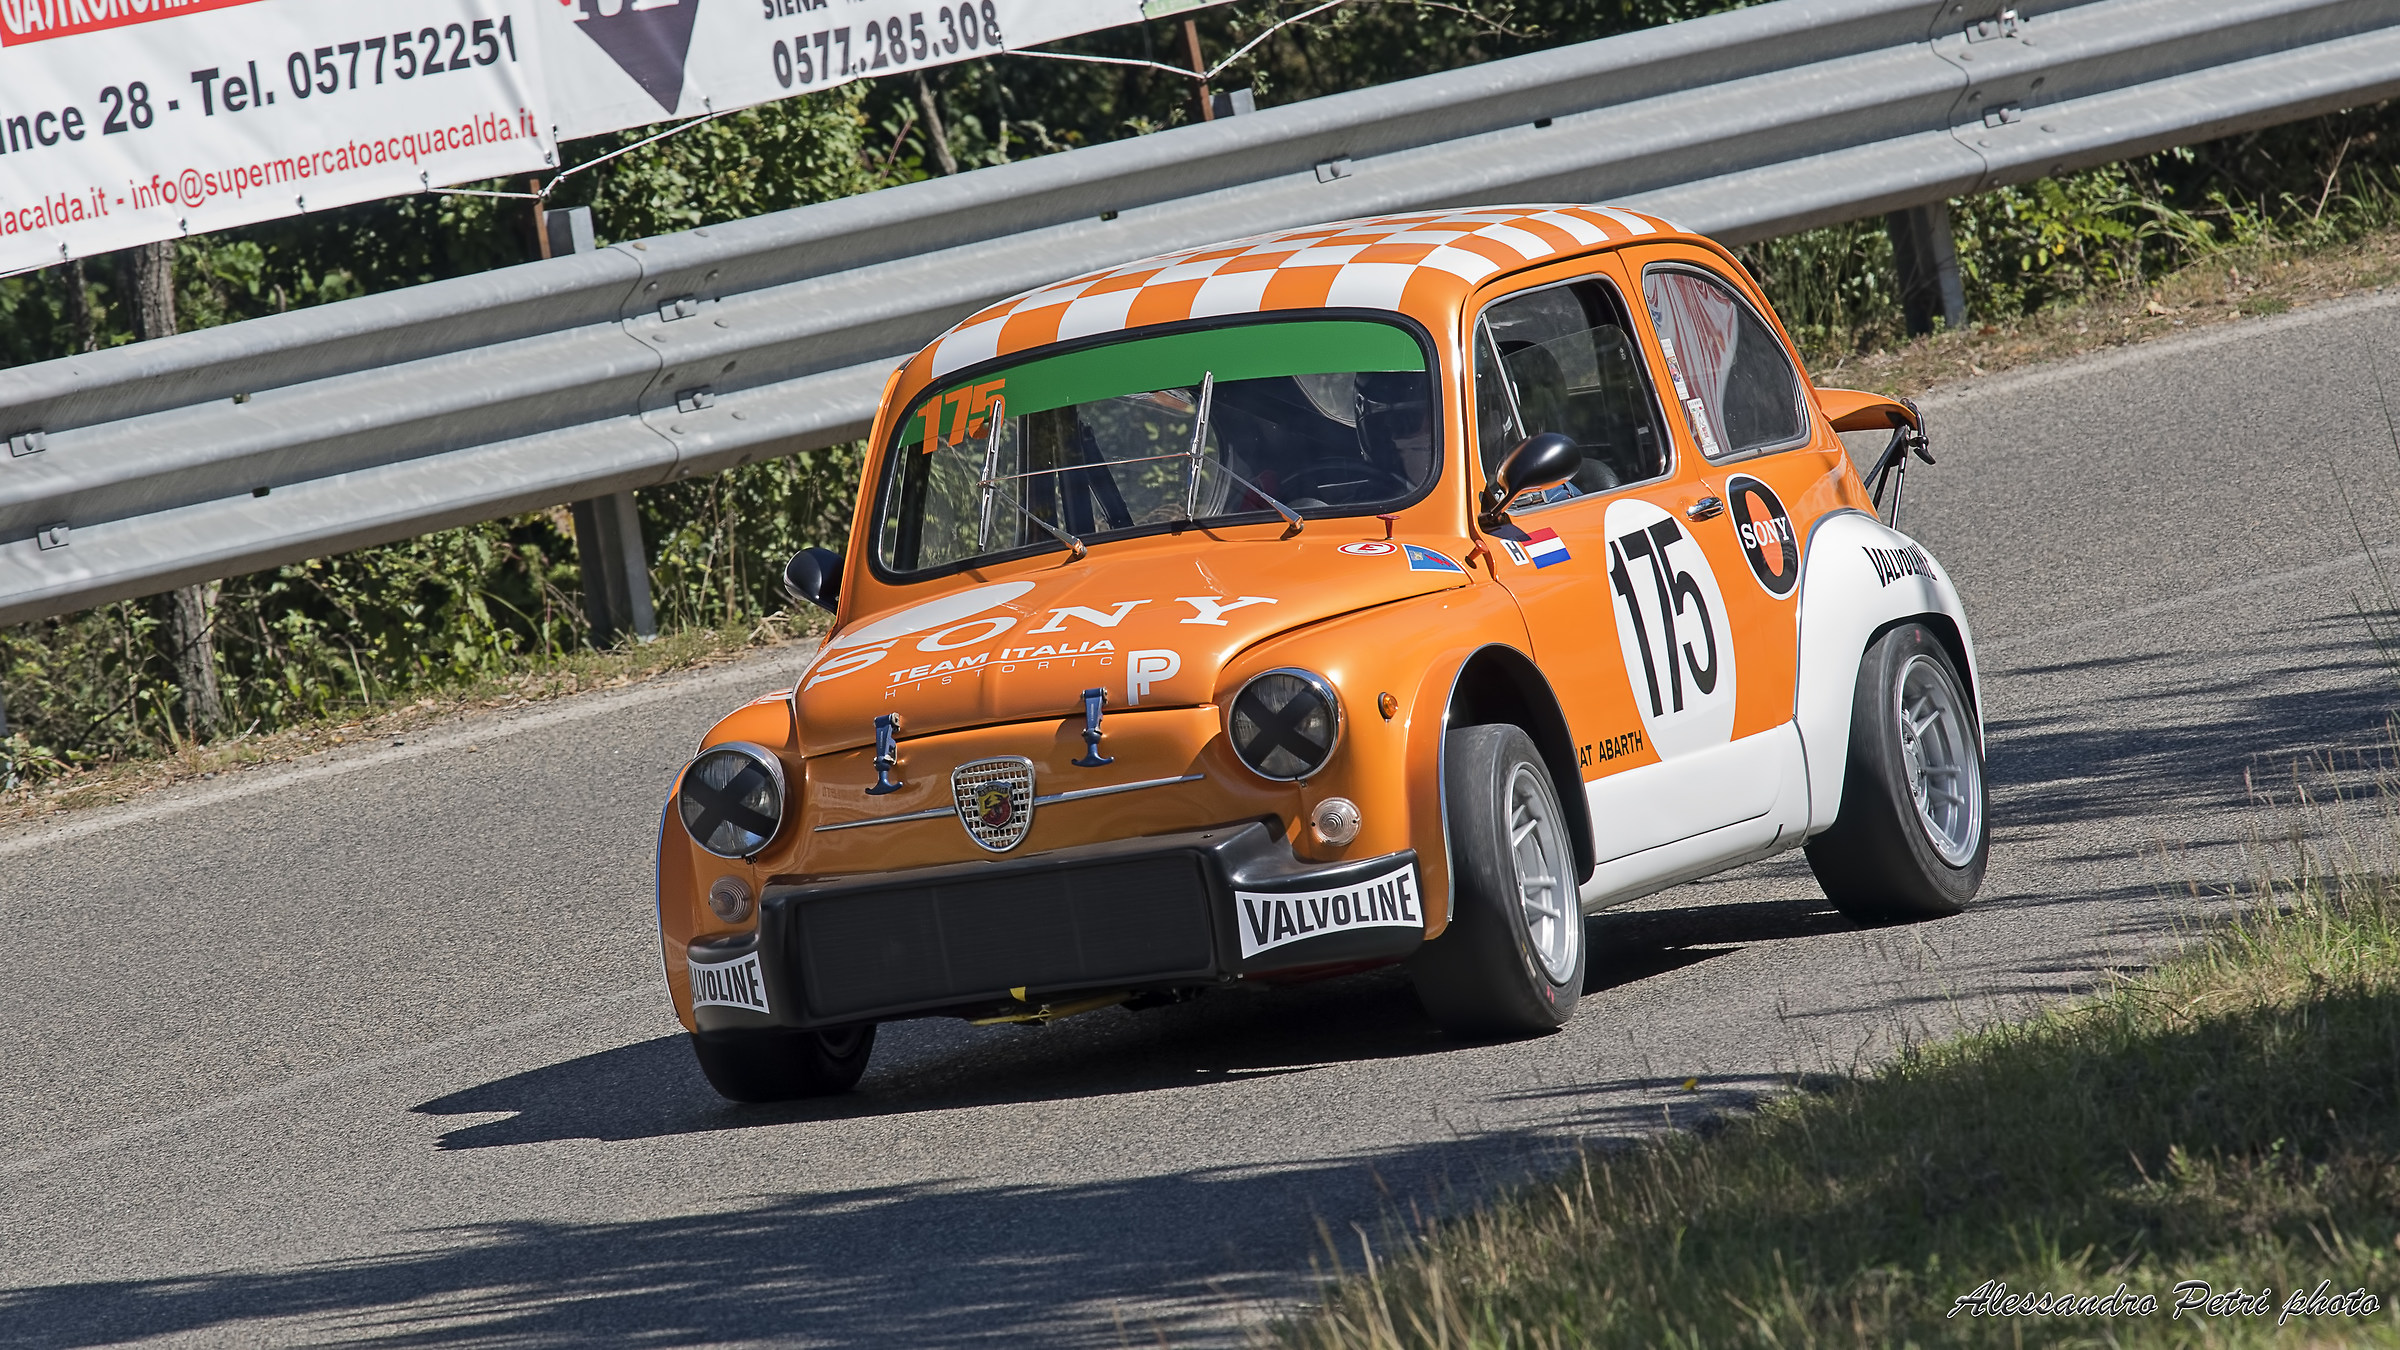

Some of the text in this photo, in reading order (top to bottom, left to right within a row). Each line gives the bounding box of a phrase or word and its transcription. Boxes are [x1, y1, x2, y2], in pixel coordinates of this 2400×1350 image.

[99, 81, 154, 136] 28
[191, 61, 275, 118] Tel.
[287, 15, 518, 99] 057752251
[773, 0, 999, 89] 0577.285.308
[130, 108, 538, 208] info@supermercatoacquacalda.it
[917, 378, 1006, 455] 175
[1740, 516, 1790, 550] SONY
[1862, 543, 1938, 588] VALVOLINE
[804, 596, 1279, 692] SONY
[1609, 517, 1719, 718] 175
[884, 656, 1113, 700] HISTORIC
[888, 639, 1115, 684] TEAM ITALIA
[1599, 729, 1644, 763] ABARTH
[1243, 872, 1417, 947] VALVOLINE
